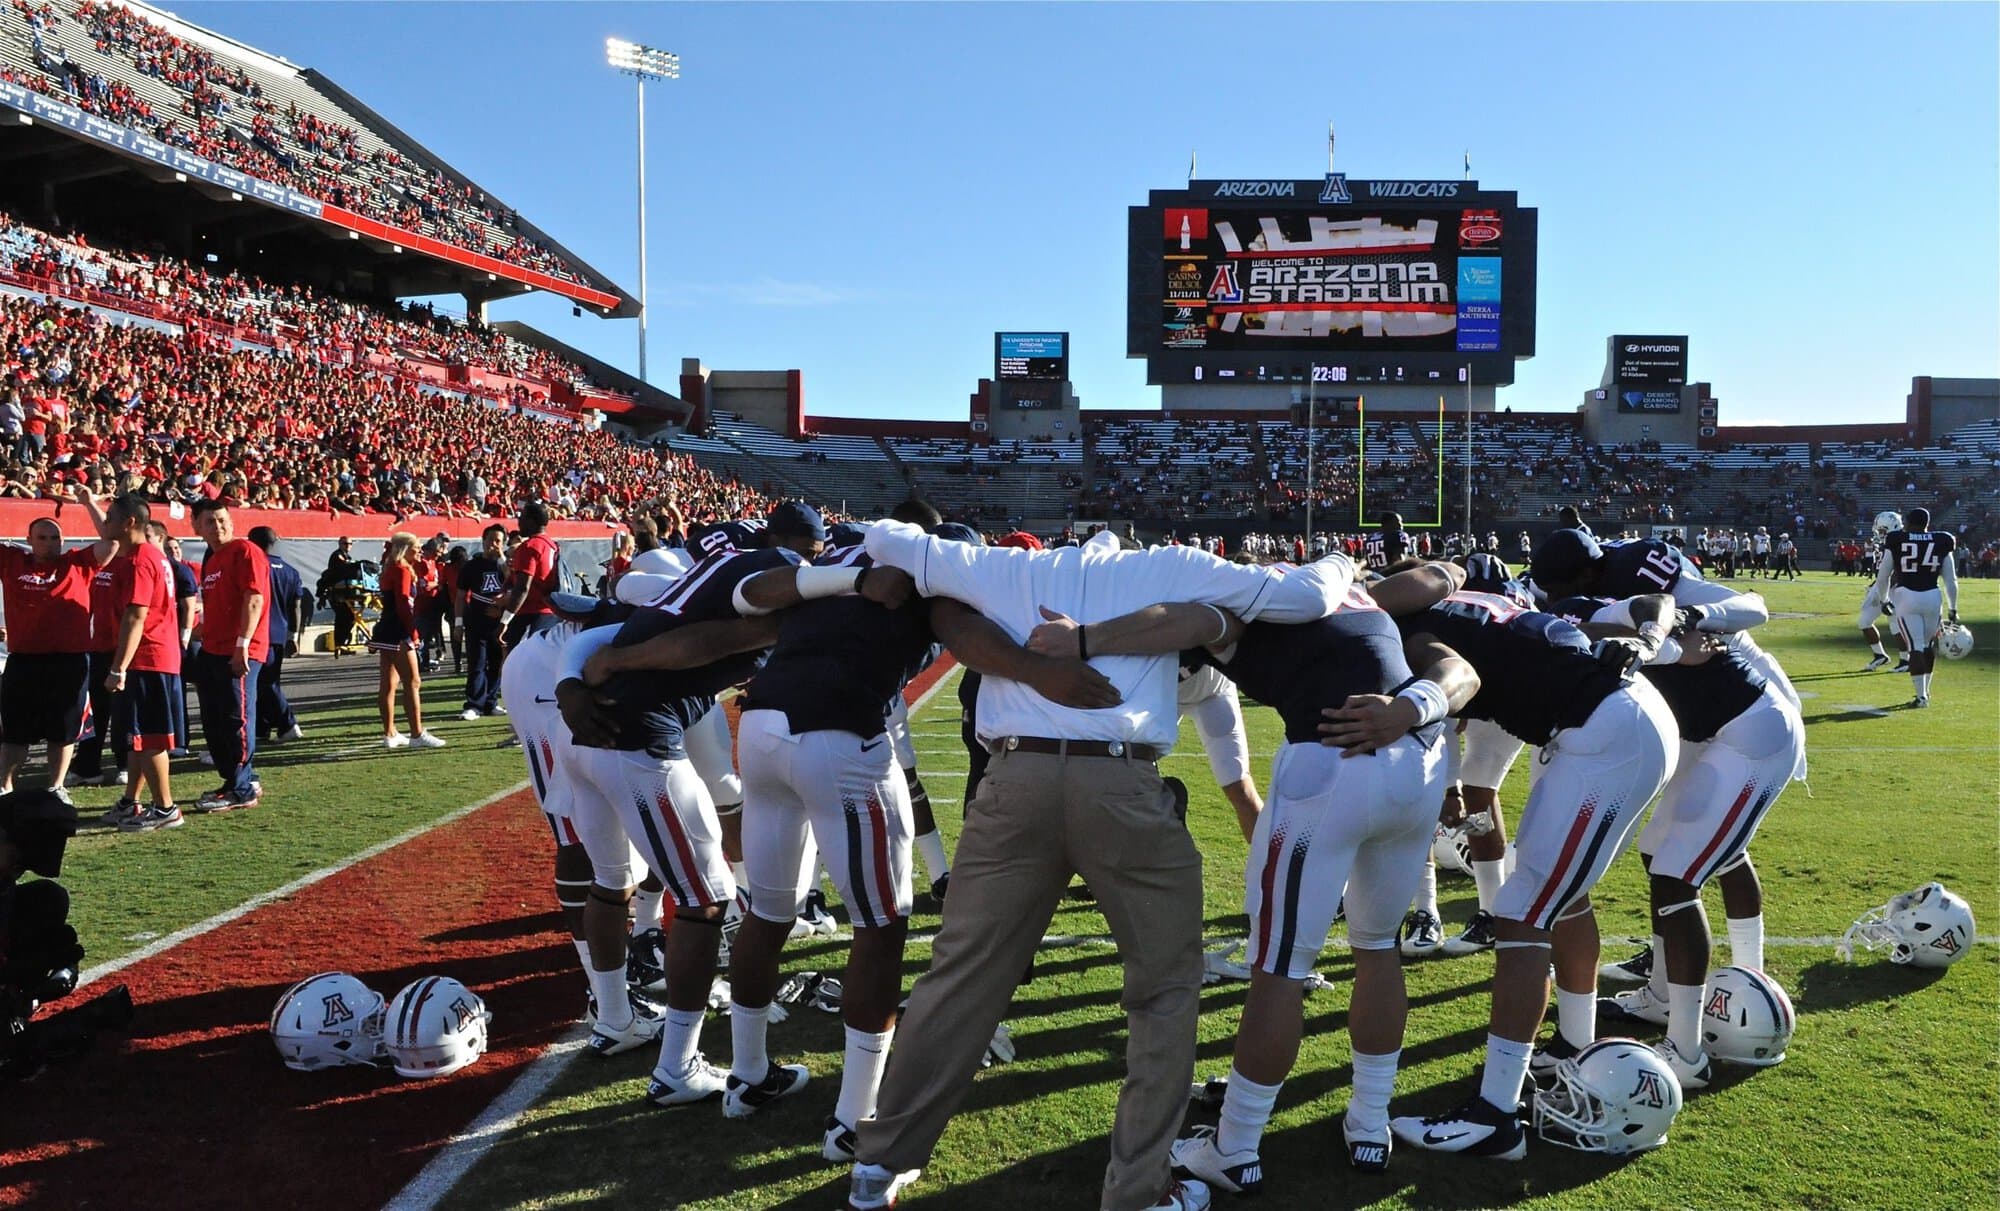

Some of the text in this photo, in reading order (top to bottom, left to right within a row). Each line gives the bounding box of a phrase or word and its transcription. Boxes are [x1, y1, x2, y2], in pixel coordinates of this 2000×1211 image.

[1213, 182, 1295, 197] ARIZONA
[1369, 182, 1459, 197] WILDCATS
[1251, 257, 1324, 267] WELCOME TO
[1168, 272, 1201, 281] CASINO
[1250, 262, 1438, 284] ARIZONA
[1168, 281, 1201, 289] DEL SOL
[1169, 290, 1200, 298] 11/11/11
[1248, 282, 1449, 303] STADIUM
[1458, 312, 1500, 320] SOUTHWEST
[1641, 345, 1680, 353] HYUNDAI
[1313, 367, 1347, 381] 22:06
[1017, 399, 1042, 407] zero
[1366, 540, 1388, 568] 25
[1901, 542, 1941, 573] 24
[1637, 549, 1680, 590] 16
[1354, 1145, 1385, 1164] NIKE
